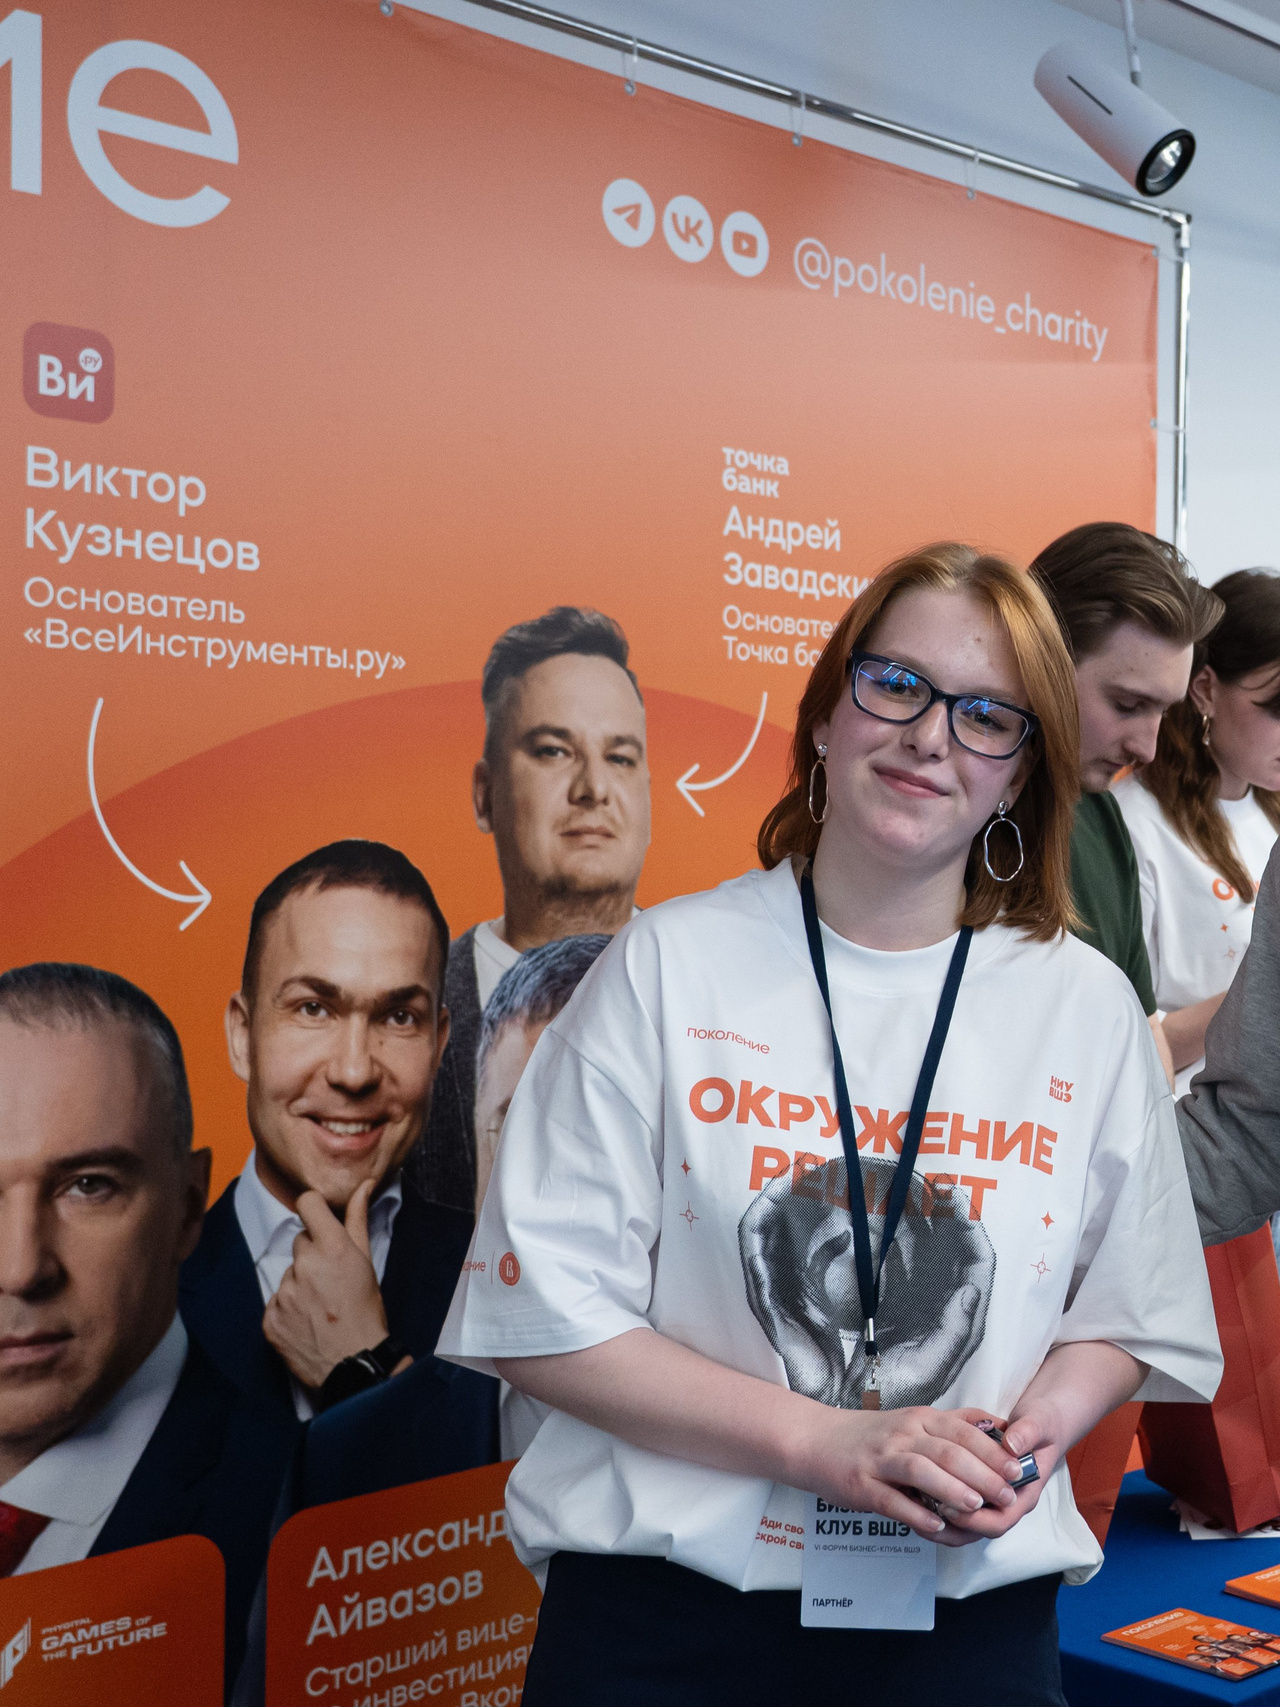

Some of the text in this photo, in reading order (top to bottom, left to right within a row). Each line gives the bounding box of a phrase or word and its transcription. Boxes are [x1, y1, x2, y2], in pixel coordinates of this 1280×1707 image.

[793, 238, 1108, 362] @pokolenie_charity
[26, 445, 207, 515] Виктор
[722, 447, 790, 476] точка
[722, 468, 779, 498] банк
[25, 507, 260, 573] Кузнецов
[723, 506, 841, 554] Андрей
[723, 553, 873, 600] Завадски
[23, 576, 245, 623] Основатель
[722, 604, 838, 638] Основате
[23, 617, 406, 678] «ВсеИнструменты.ру»
[722, 635, 788, 665] Точка
[687, 1027, 770, 1054] поколение
[1049, 1086, 1072, 1103] ВШЭ
[1050, 1075, 1074, 1092] НИУ
[689, 1076, 1058, 1176] ОКРУЖЕНИЕ
[784, 1523, 805, 1535] сво
[816, 1519, 911, 1537] КЛУБ ВШЭ
[822, 1544, 848, 1552] ФОРУМ
[904, 1546, 921, 1554] ВШЭ
[305, 1569, 484, 1646] Айвазов
[812, 1598, 854, 1608] ПАРТНЁР
[41, 1615, 152, 1651] GAMES OF
[41, 1622, 168, 1662] THE FUTURE
[305, 1628, 448, 1697] Старший
[353, 1643, 534, 1707] нвестиция
